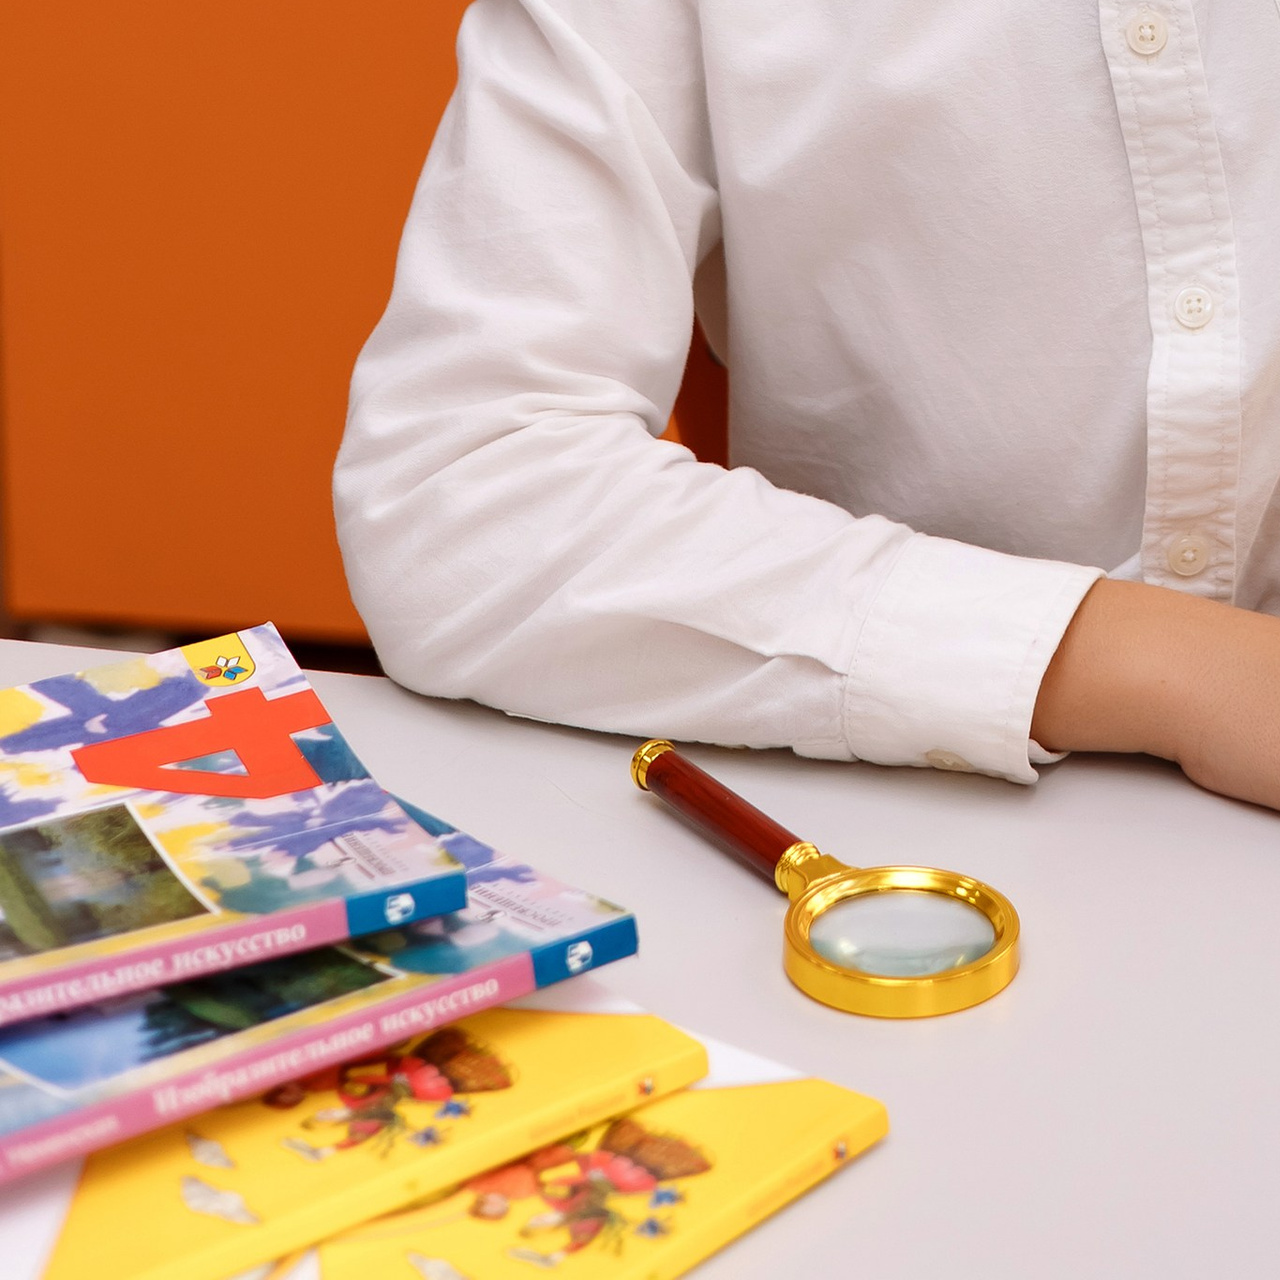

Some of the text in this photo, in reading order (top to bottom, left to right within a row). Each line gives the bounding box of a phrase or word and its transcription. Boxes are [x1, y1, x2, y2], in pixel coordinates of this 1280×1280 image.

[70, 686, 333, 799] 4
[171, 923, 307, 973] искусство
[380, 976, 499, 1042] искусство
